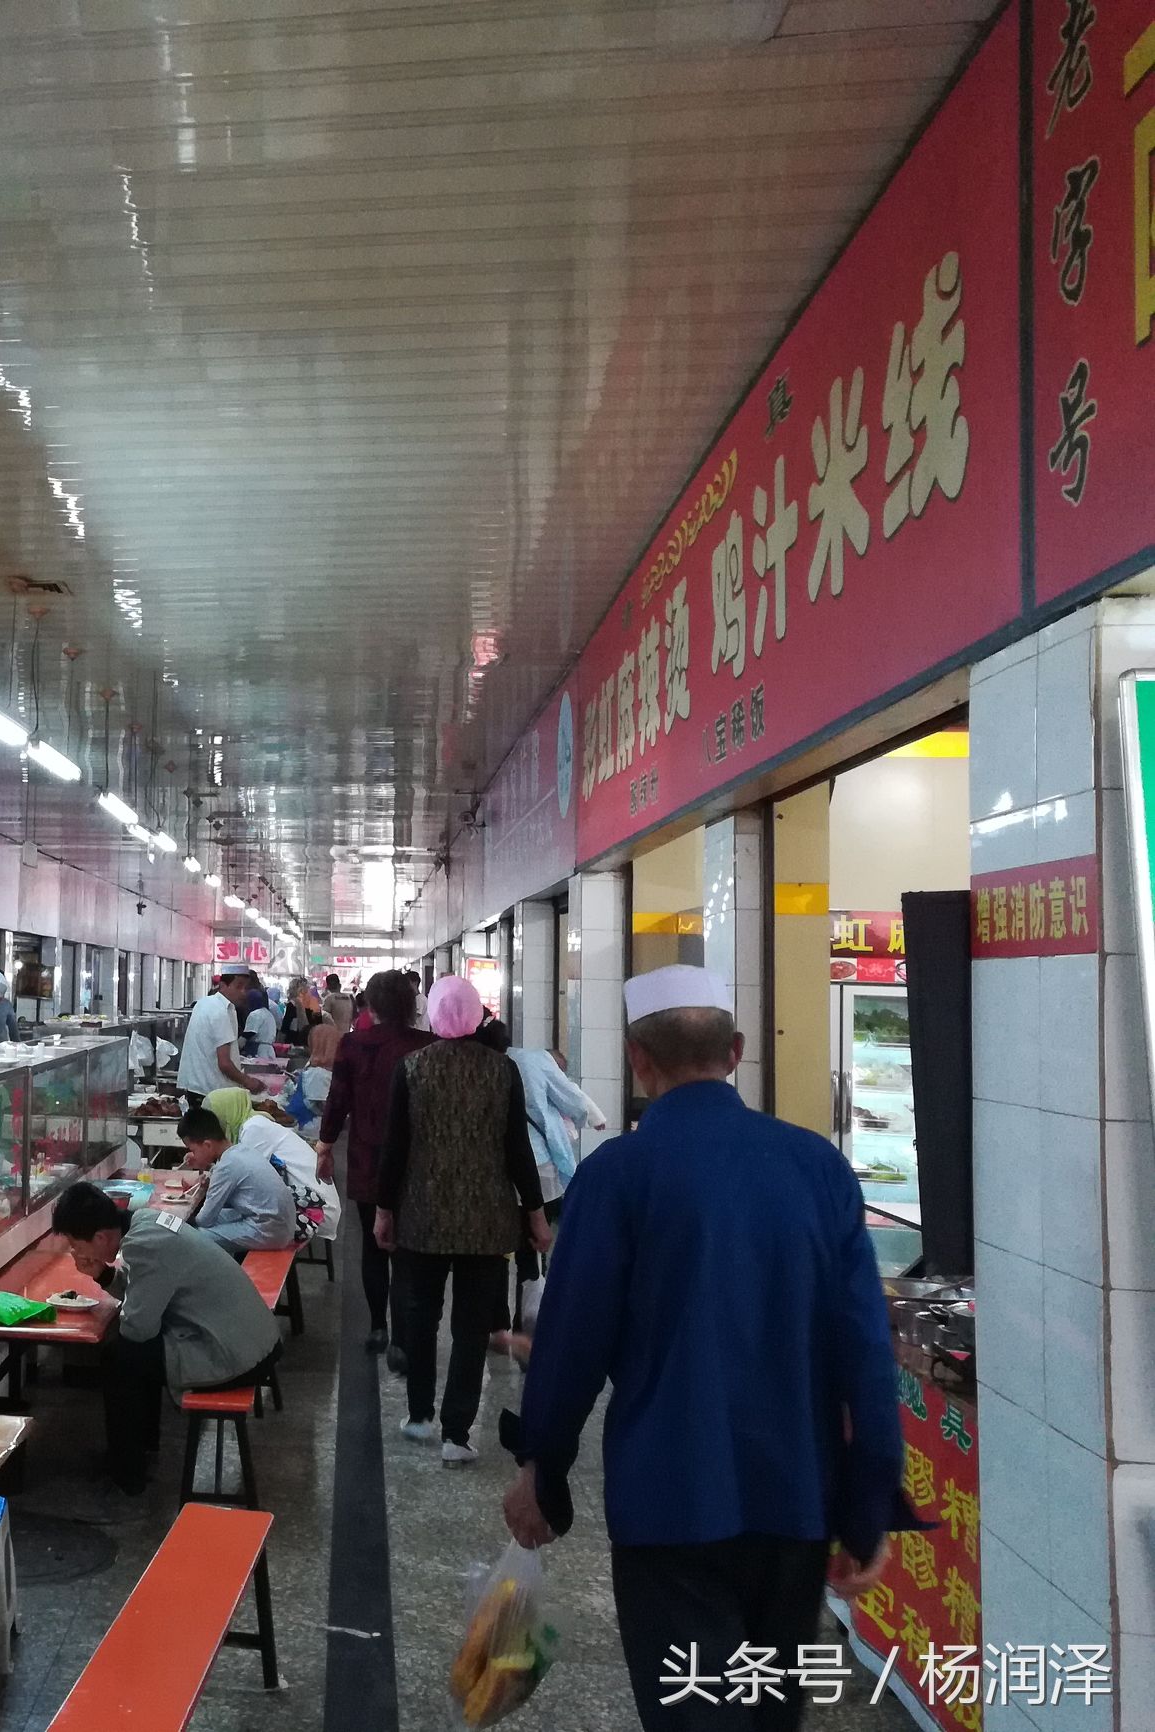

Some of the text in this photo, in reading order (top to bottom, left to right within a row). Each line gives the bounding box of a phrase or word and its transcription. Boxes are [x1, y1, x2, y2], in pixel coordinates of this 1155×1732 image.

[581, 251, 969, 803] 彩虹麻辣烫 鸡汁米线
[976, 876, 1090, 946] 增强消防意识
